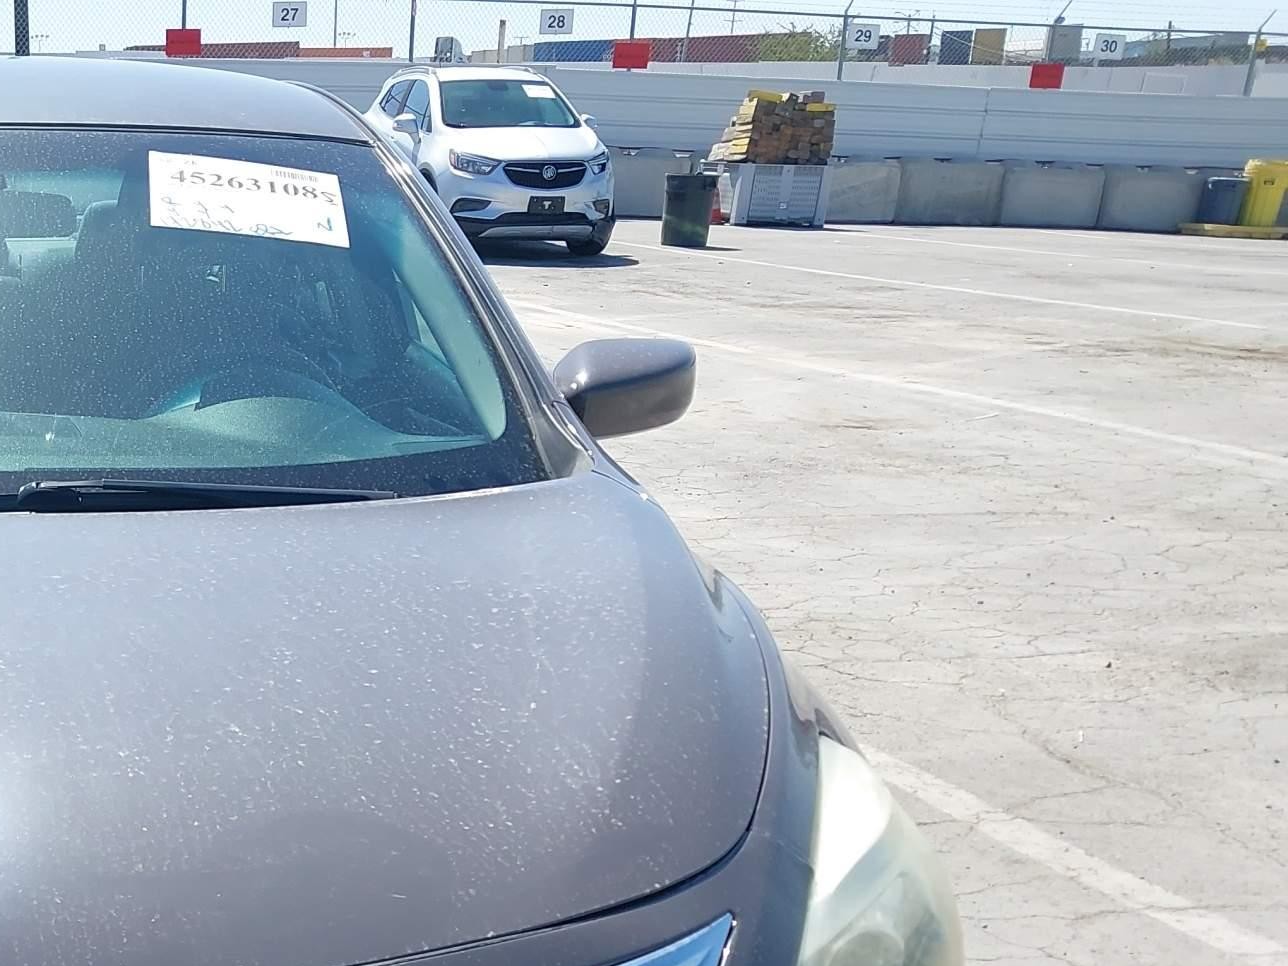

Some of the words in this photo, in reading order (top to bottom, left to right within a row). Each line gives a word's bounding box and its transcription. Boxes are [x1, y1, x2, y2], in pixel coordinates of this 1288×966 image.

[280, 7, 299, 21] 27
[547, 14, 566, 29] 28
[854, 29, 872, 43] 29
[1100, 39, 1118, 53] 30
